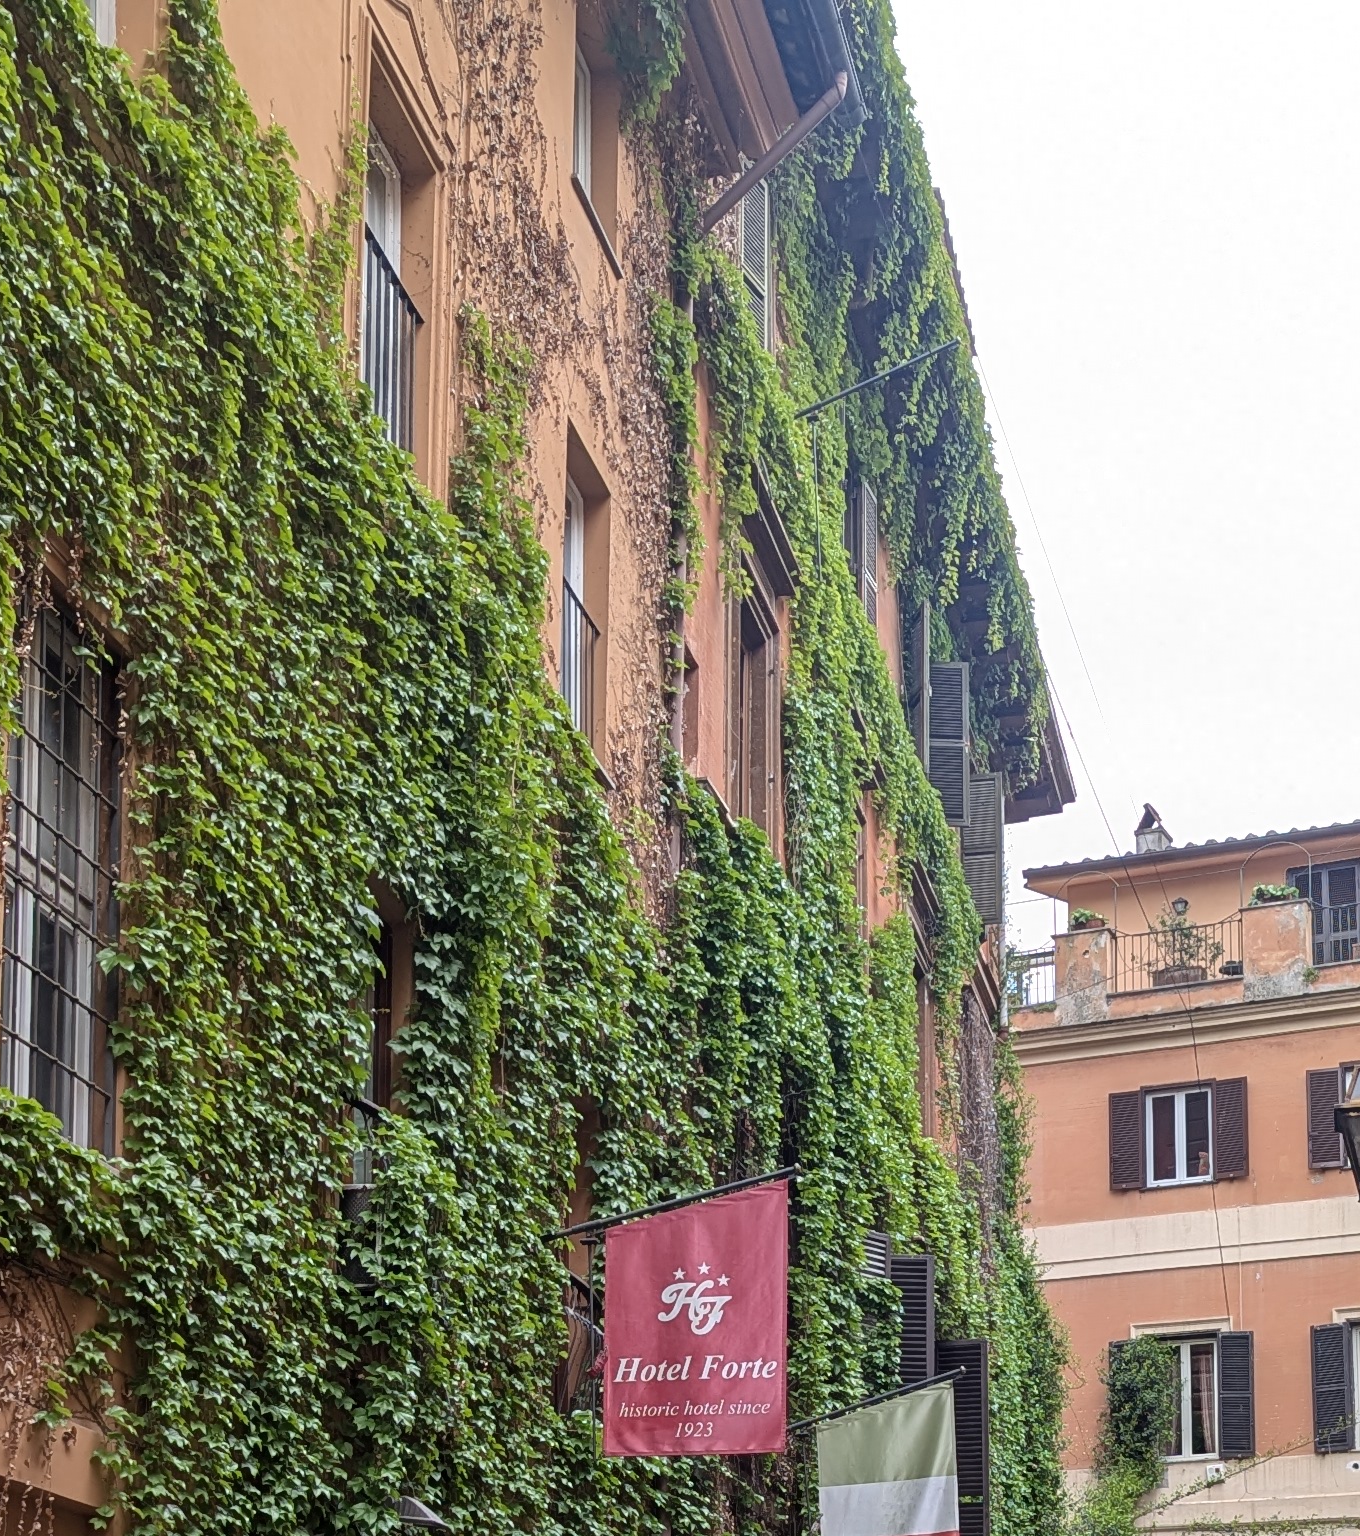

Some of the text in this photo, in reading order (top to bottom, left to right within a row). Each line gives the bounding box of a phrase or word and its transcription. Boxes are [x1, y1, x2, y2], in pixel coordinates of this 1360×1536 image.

[613, 1354, 778, 1383] Hotel Forte
[618, 1399, 771, 1418] historic hotel since
[674, 1421, 713, 1438] 1923
